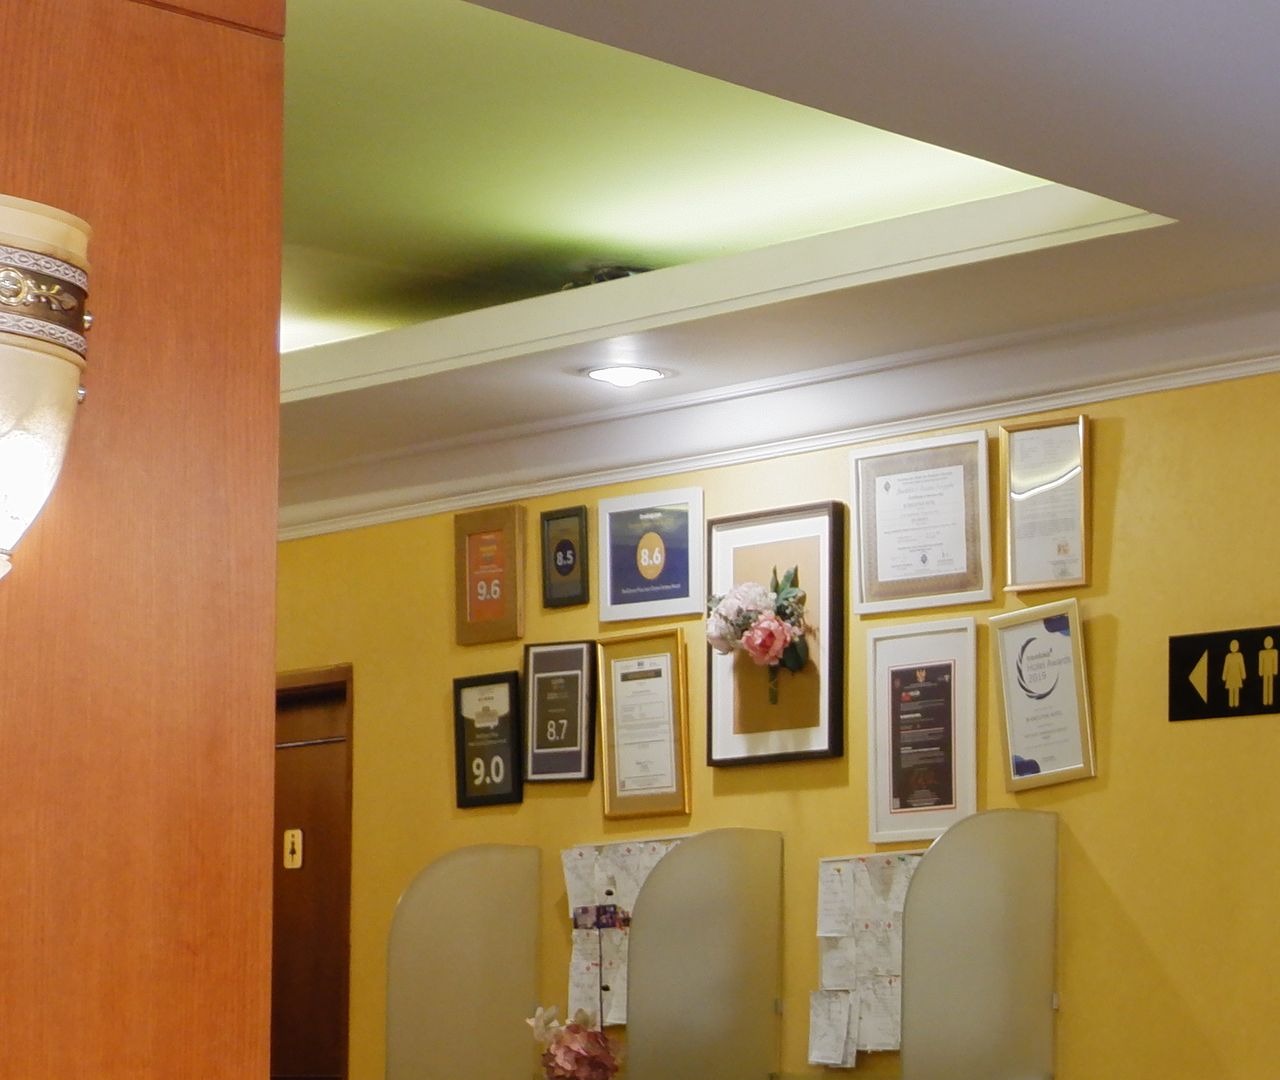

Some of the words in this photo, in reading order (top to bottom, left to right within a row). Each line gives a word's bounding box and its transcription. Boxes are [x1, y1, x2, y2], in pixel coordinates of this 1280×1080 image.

[556, 550, 574, 566] 8.5
[640, 547, 661, 566] 8.6
[477, 580, 501, 600] 9.6
[547, 719, 568, 741] 8.7
[472, 755, 504, 785] 9.0
